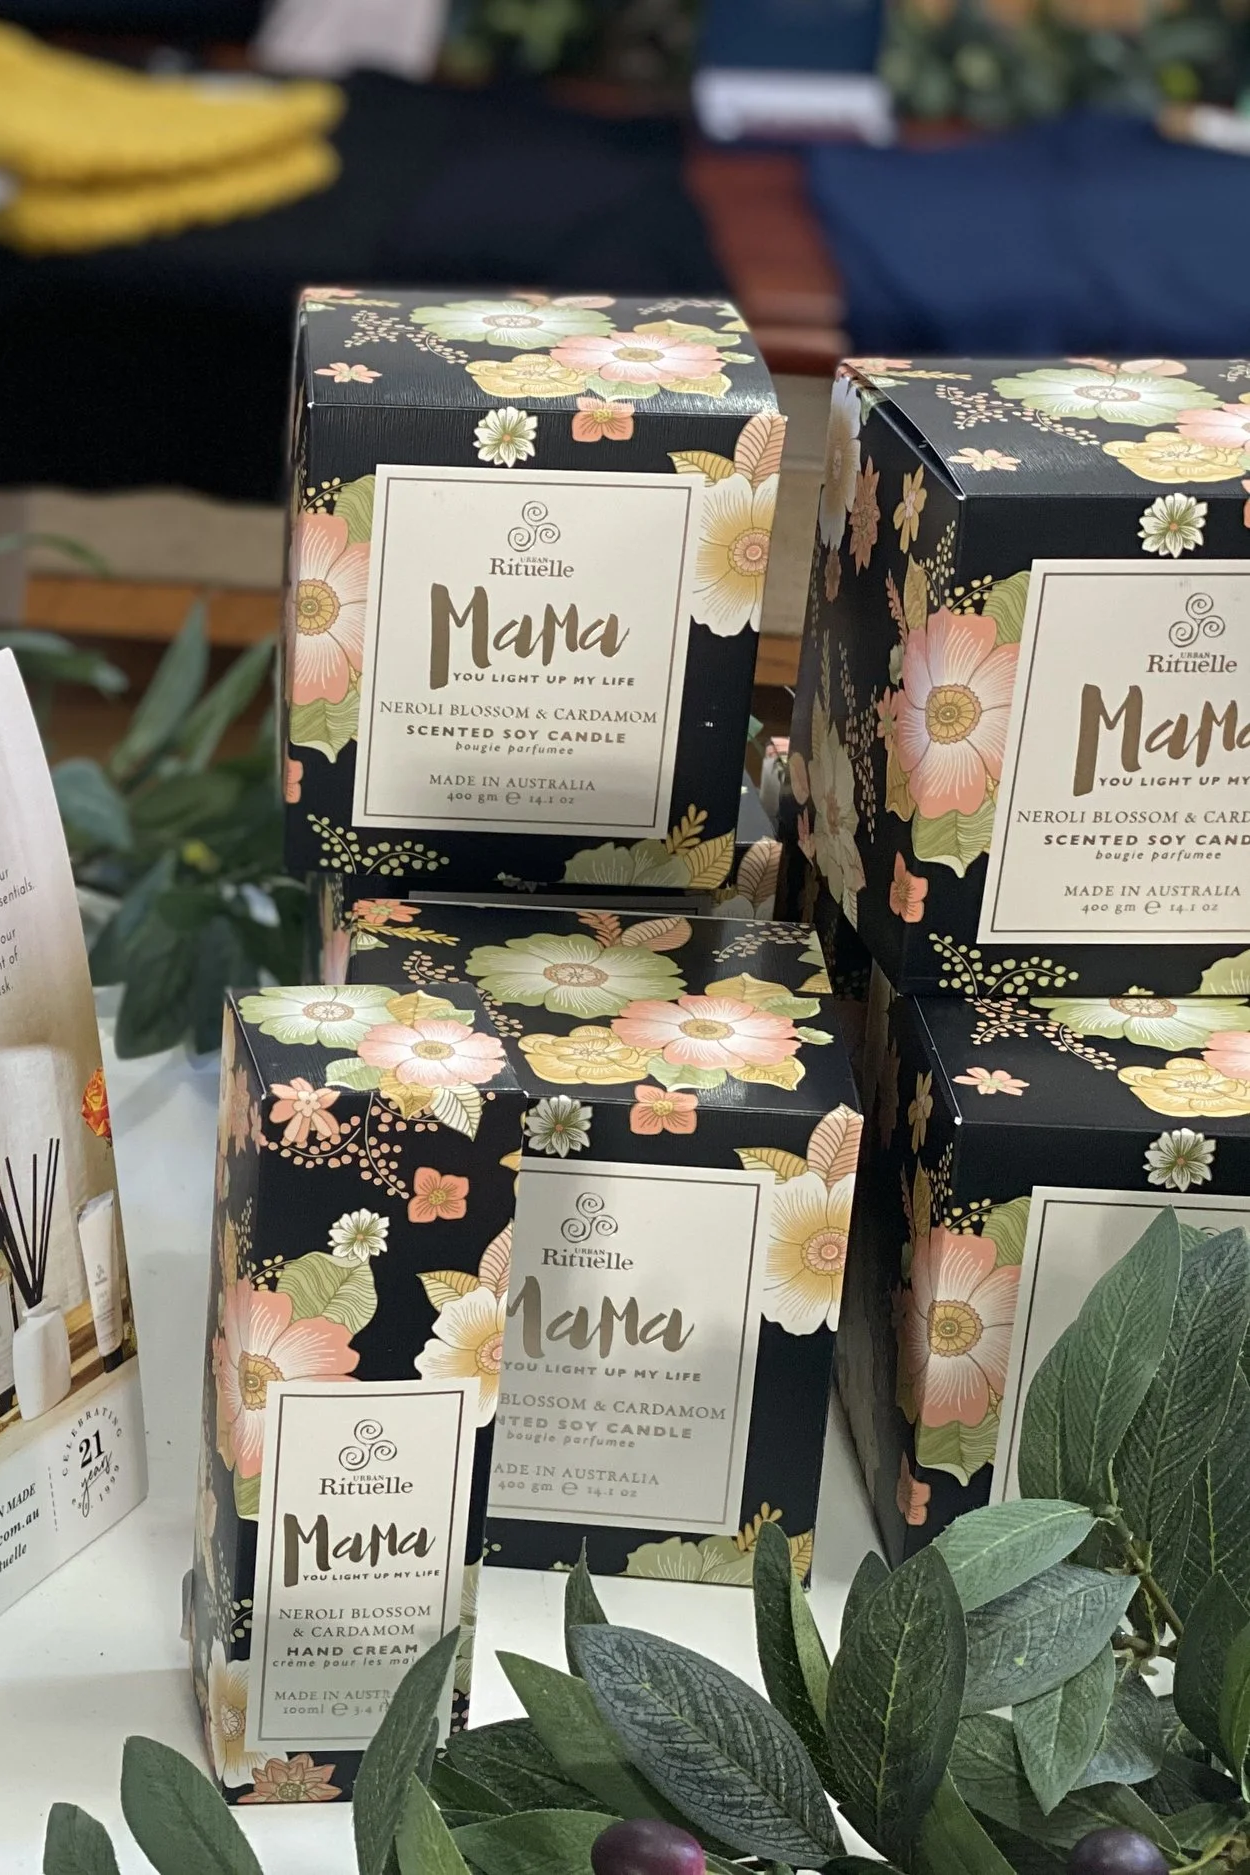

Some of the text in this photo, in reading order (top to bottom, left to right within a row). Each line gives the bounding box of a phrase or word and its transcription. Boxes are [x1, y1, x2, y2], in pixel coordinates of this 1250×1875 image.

[489, 557, 574, 577] Rituelle
[1146, 655, 1237, 673] Rituelle
[453, 672, 635, 686] YOU LIGHT UP MY LIFE
[380, 702, 657, 724] NEROLI BLOSSOM & CARDAMOM
[406, 725, 626, 743] SCENTED SOY CANDLE
[455, 742, 574, 756] bougie parfumee
[429, 774, 595, 791] MADE IN AUSTRALIA
[1100, 777, 1250, 786] YOU LIGHT UP MY
[1017, 811, 1196, 824] NEROLI BLOSSOM &
[1044, 835, 1250, 846] SCENTED SOY CAND
[1096, 850, 1221, 862] bougie parfumee
[1064, 886, 1241, 896] MADE IN AUSTRALIA
[1081, 904, 1218, 914] 400 gm 14.1 oz
[1, 928, 16, 944] our
[9, 945, 18, 963] of
[541, 1248, 634, 1271] Rituelle
[504, 1361, 701, 1382] YOU LIGHT UP MY LIFE
[501, 1393, 726, 1420] BLOSSOM & CARDAMOM
[558, 1420, 693, 1439] SOY CANDLE
[62, 1407, 122, 1476] CELEBRATING
[507, 1431, 636, 1448] bougie parfumee
[79, 1429, 104, 1469] 21
[494, 1463, 659, 1485] ADE IN AUSTRALIA
[318, 1476, 413, 1495] Rituelle
[6, 1482, 36, 1514] MADE
[333, 1573, 369, 1581] LIGHT
[279, 1605, 431, 1619] NEROLI BLOSSOM
[293, 1624, 415, 1637] & CARDAMOM
[287, 1644, 418, 1656] HAND CREAM
[273, 1658, 382, 1669] crème pour les
[275, 1691, 339, 1700] MADE IN
